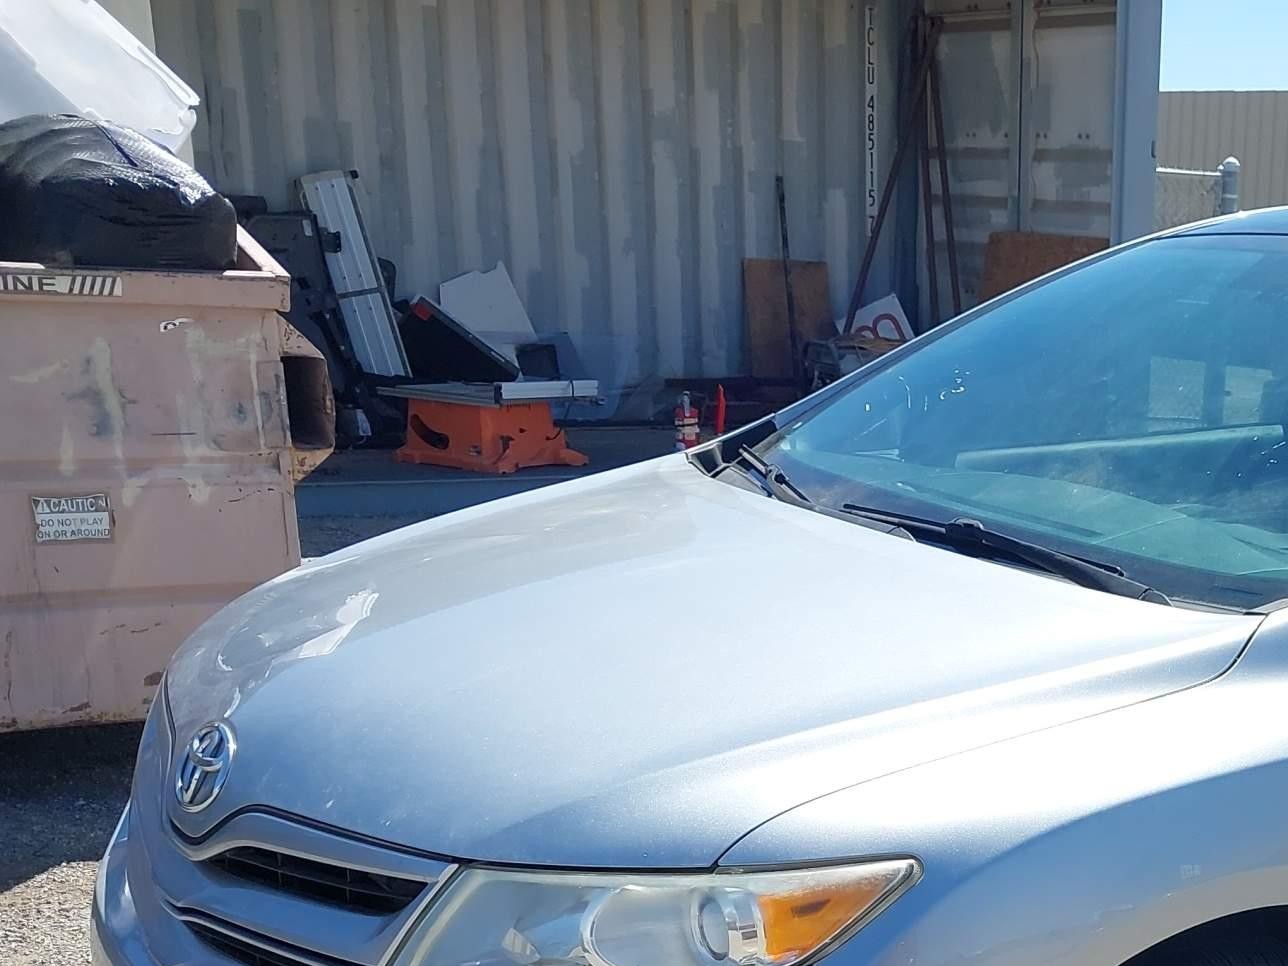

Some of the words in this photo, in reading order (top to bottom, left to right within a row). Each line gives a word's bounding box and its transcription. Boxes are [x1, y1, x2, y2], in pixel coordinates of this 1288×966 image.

[866, 7, 876, 86] TCLU
[866, 94, 877, 208] 485115
[37, 531, 51, 539] ON
[54, 530, 68, 538] OR
[71, 529, 110, 538] AROUND
[41, 519, 54, 528] DO
[58, 518, 77, 527] NOT
[80, 517, 104, 526] PLAY
